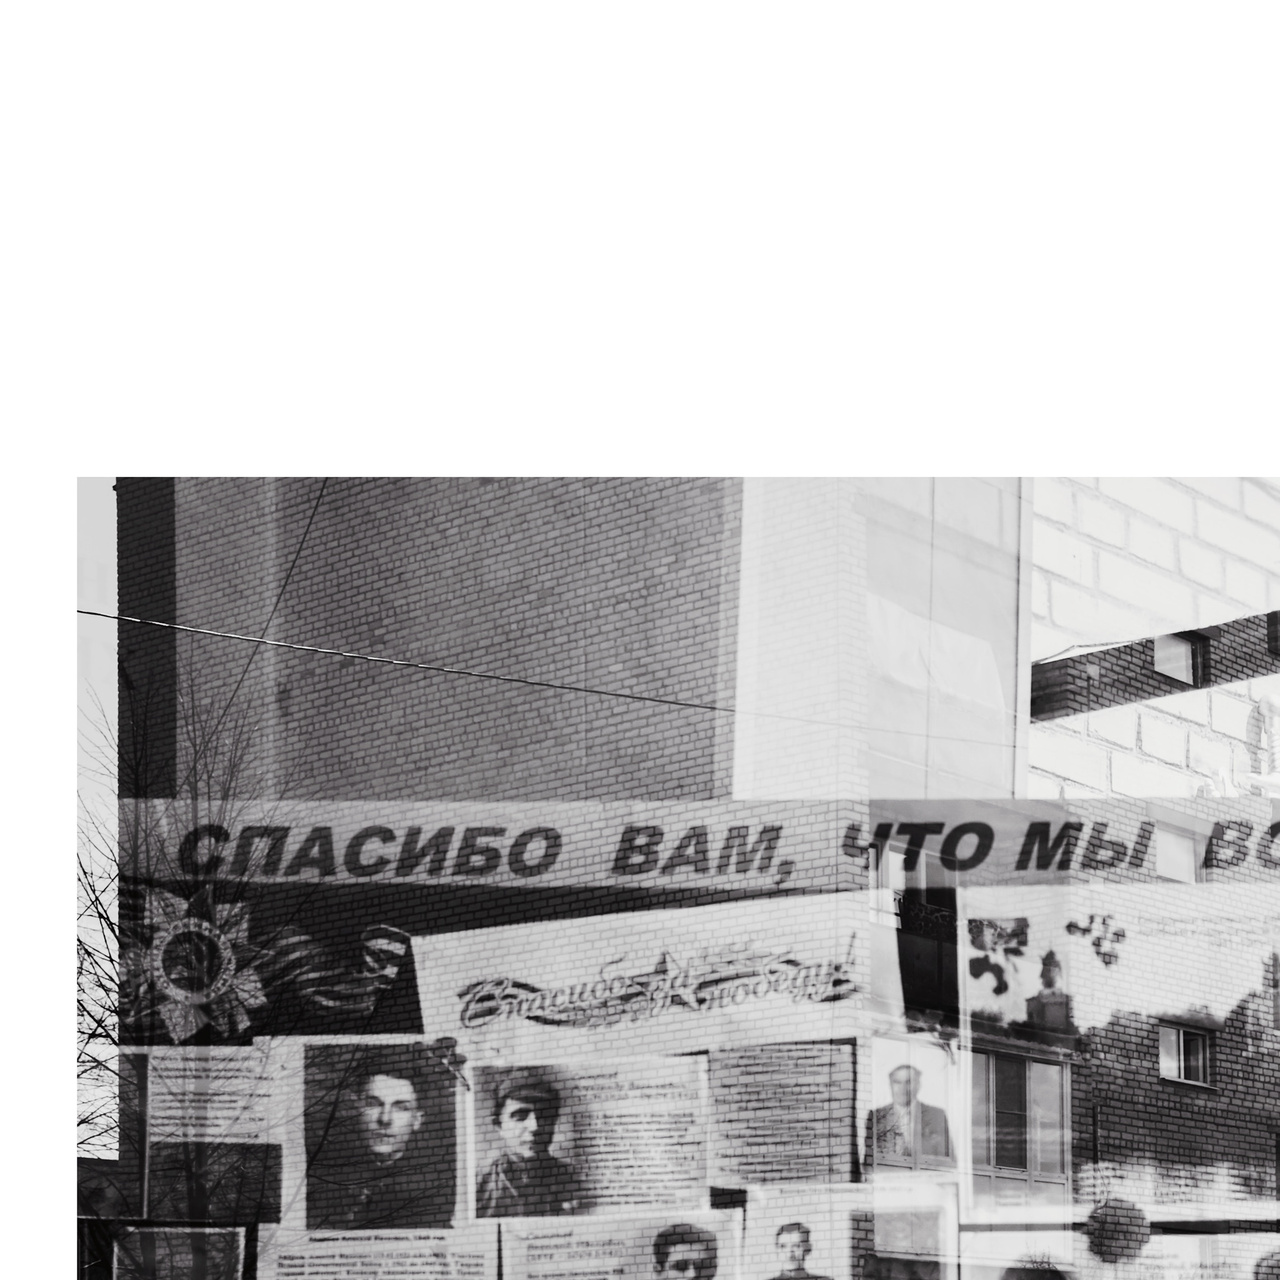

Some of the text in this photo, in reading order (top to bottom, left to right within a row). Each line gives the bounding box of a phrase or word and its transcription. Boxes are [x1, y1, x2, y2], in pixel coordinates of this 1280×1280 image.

[178, 824, 563, 878] СПАСИБО
[610, 824, 797, 886] ВАМ,
[842, 821, 995, 873] ЧТО
[1014, 820, 1157, 872] МЫ
